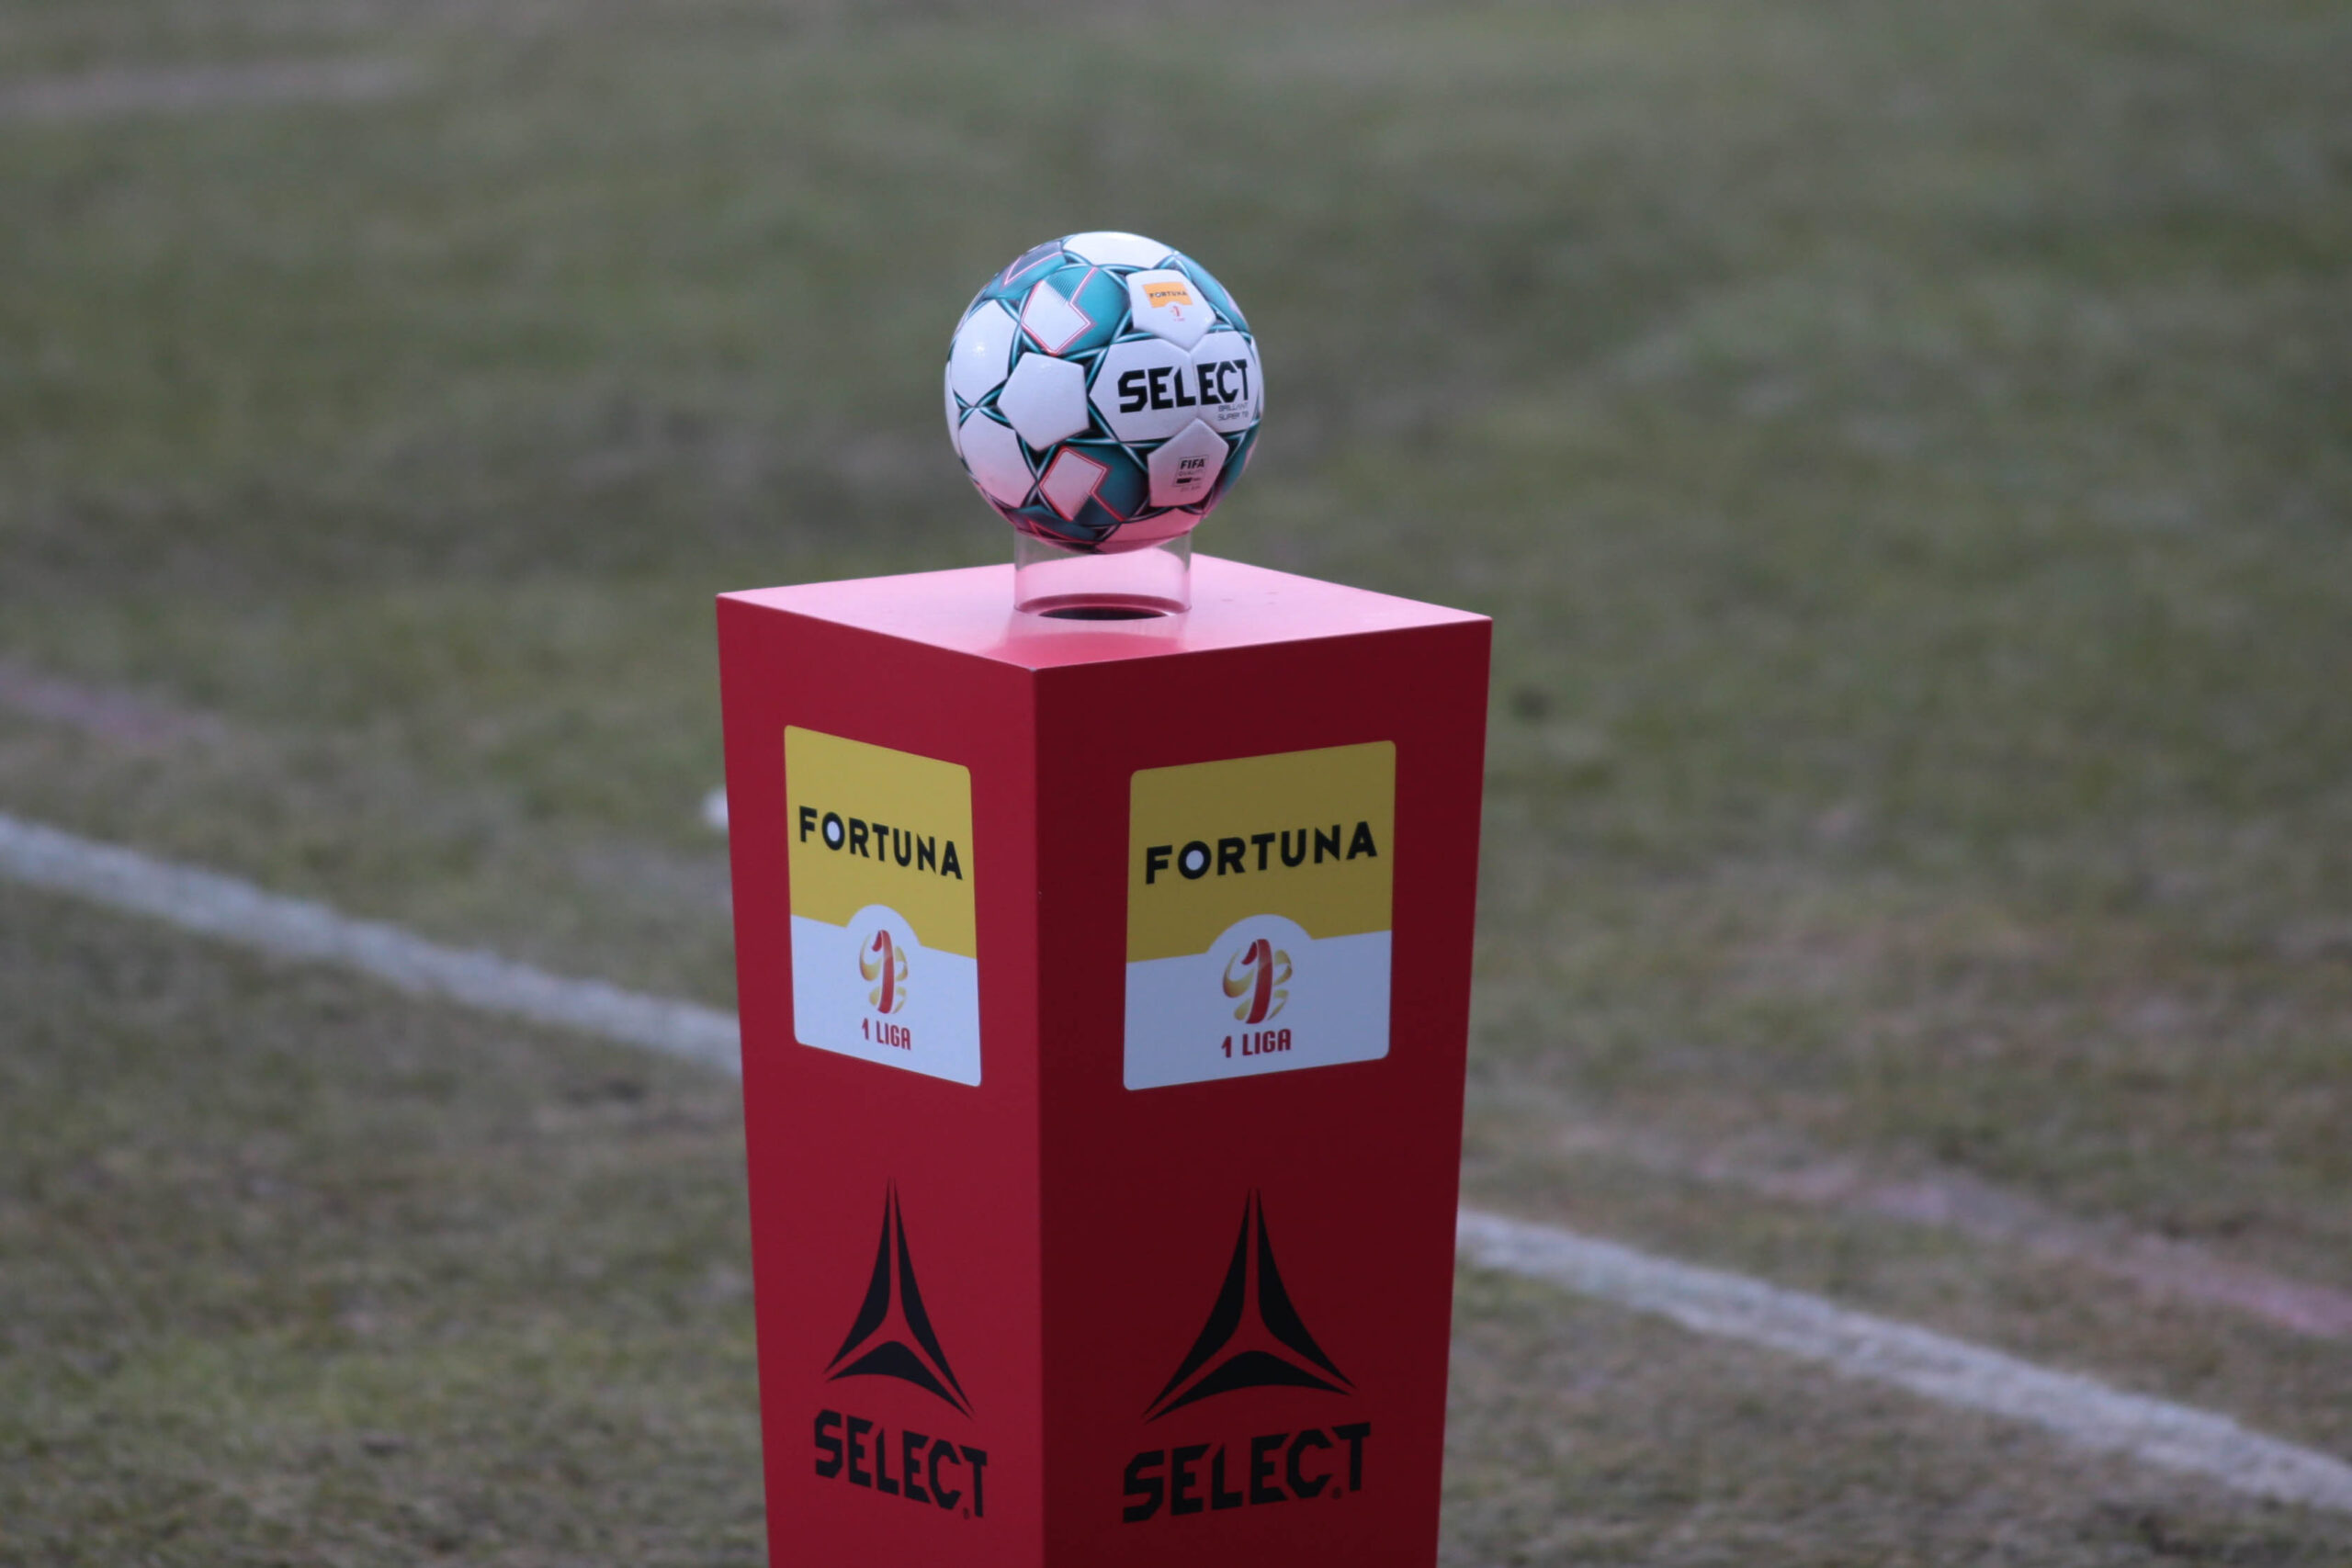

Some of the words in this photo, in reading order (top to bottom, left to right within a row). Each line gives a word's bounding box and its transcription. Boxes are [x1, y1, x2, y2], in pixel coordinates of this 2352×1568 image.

[1148, 290, 1188, 299] FORTUNA
[1117, 359, 1249, 413] SELECT
[1180, 458, 1205, 470] FIFA
[798, 805, 963, 881] FORTUNA
[1146, 820, 1377, 885] FORTUNA
[861, 1018, 870, 1041] 1
[876, 1020, 911, 1051] LIGA
[1221, 1035, 1232, 1058] 1
[1242, 1028, 1292, 1055] LIGA
[814, 1408, 988, 1518] SELECT
[1123, 1421, 1371, 1524] SELECT
